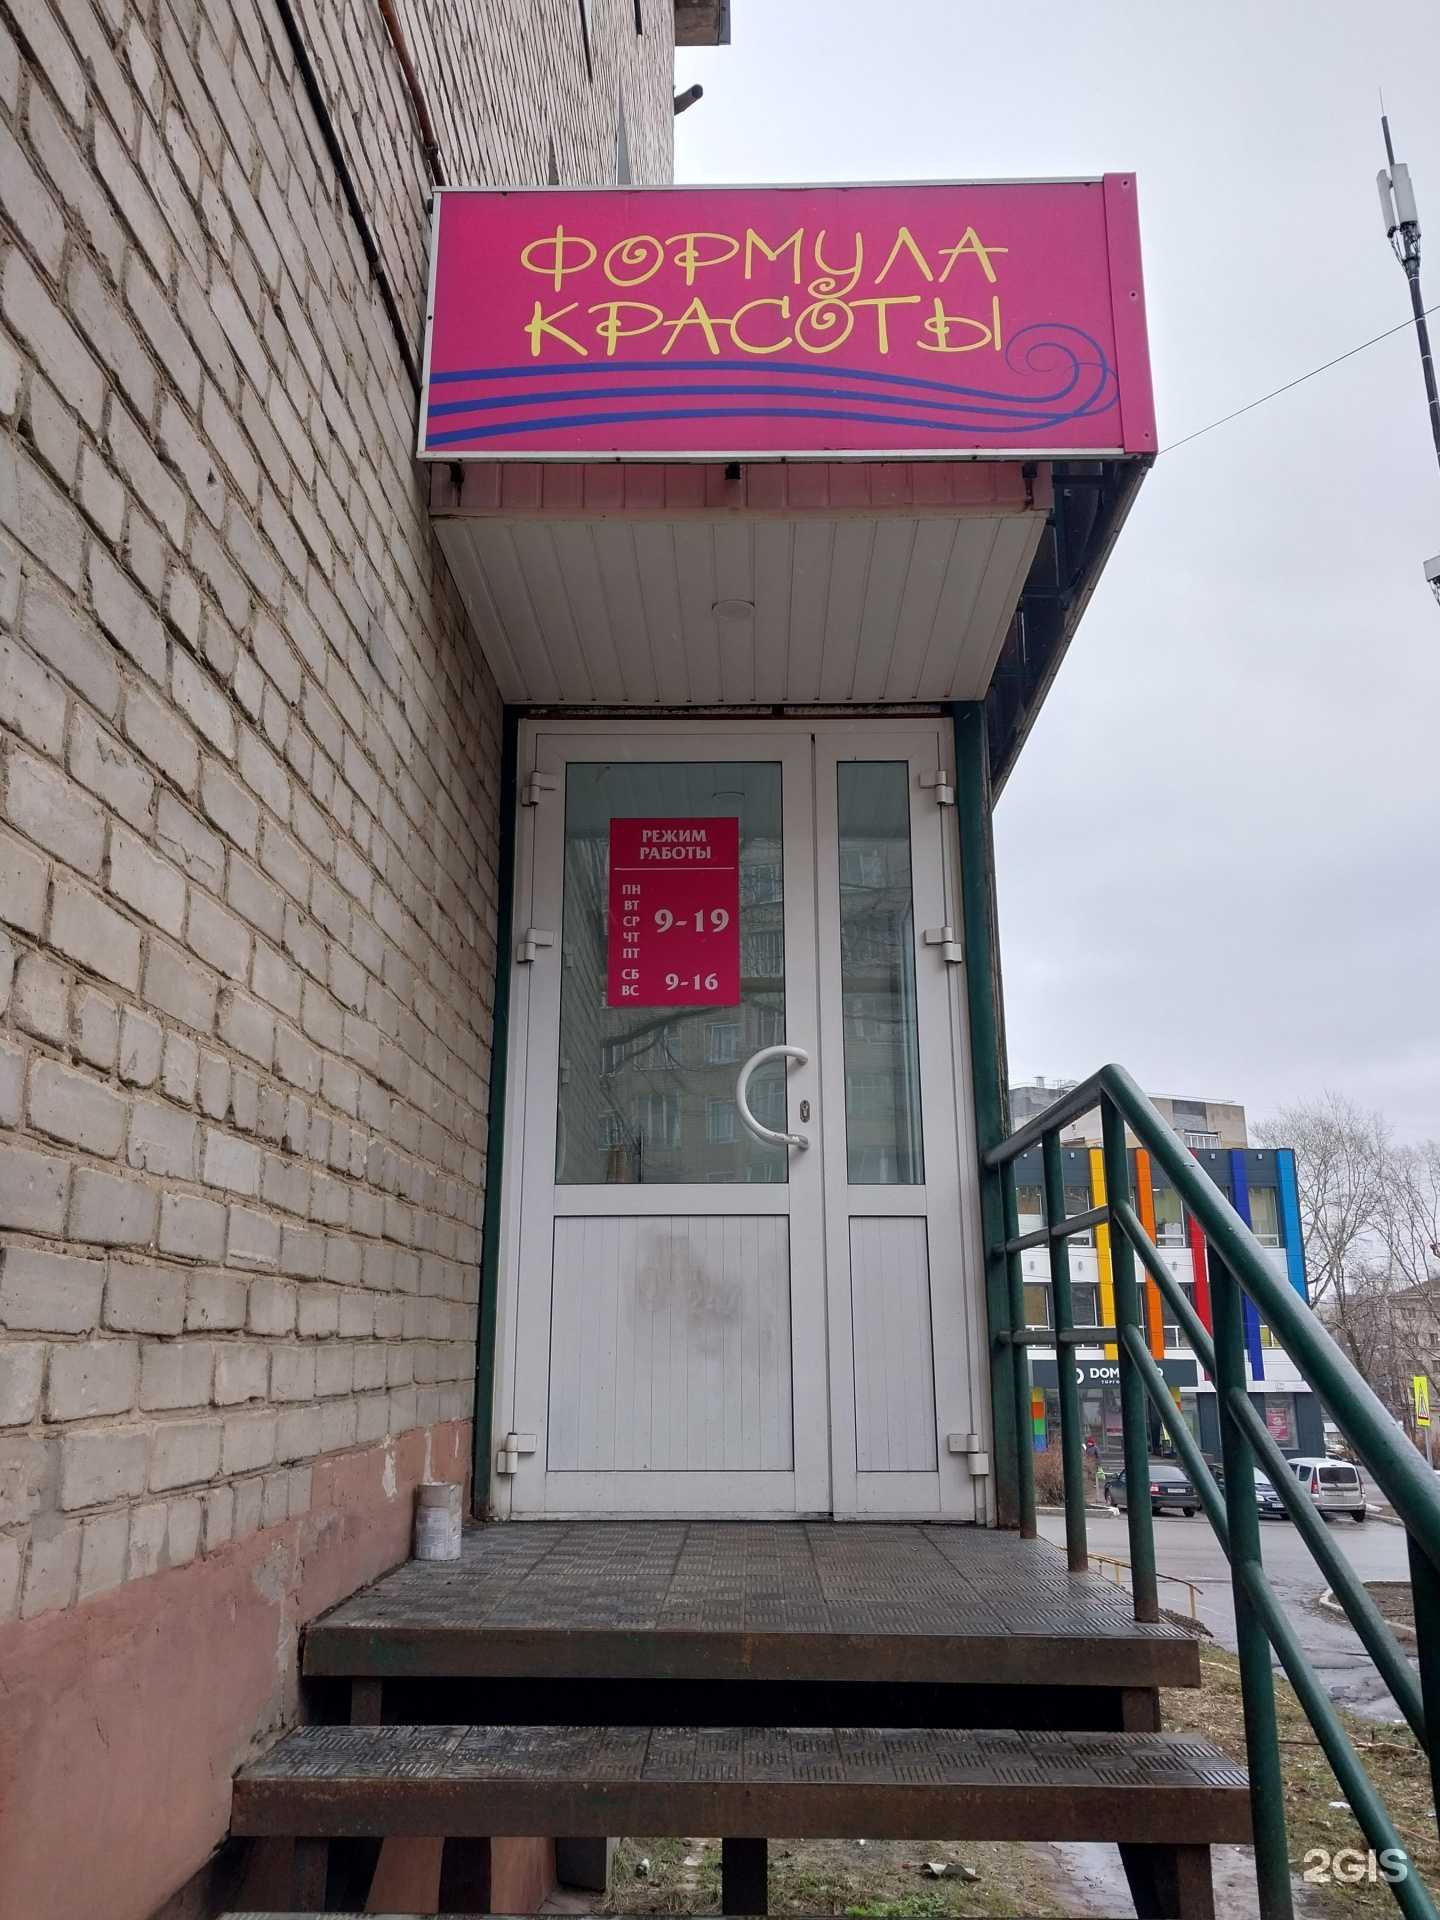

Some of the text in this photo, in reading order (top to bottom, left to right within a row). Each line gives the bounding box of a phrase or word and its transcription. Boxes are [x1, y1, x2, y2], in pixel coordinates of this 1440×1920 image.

[520, 225, 1009, 299] ФОРМУЛА
[524, 295, 1002, 357] КРАСОТЫ
[642, 830, 707, 843] РЕЖИМ
[640, 846, 711, 860] РАБОТЫ
[622, 884, 641, 895] ПН
[624, 900, 640, 911] ВТ
[623, 916, 640, 927] СР
[654, 908, 729, 933] 9-19
[623, 932, 640, 943] ЧТ
[622, 948, 640, 959] ПТ
[621, 969, 640, 979] СБ
[665, 973, 719, 991] 9-16
[621, 985, 639, 996] ВС
